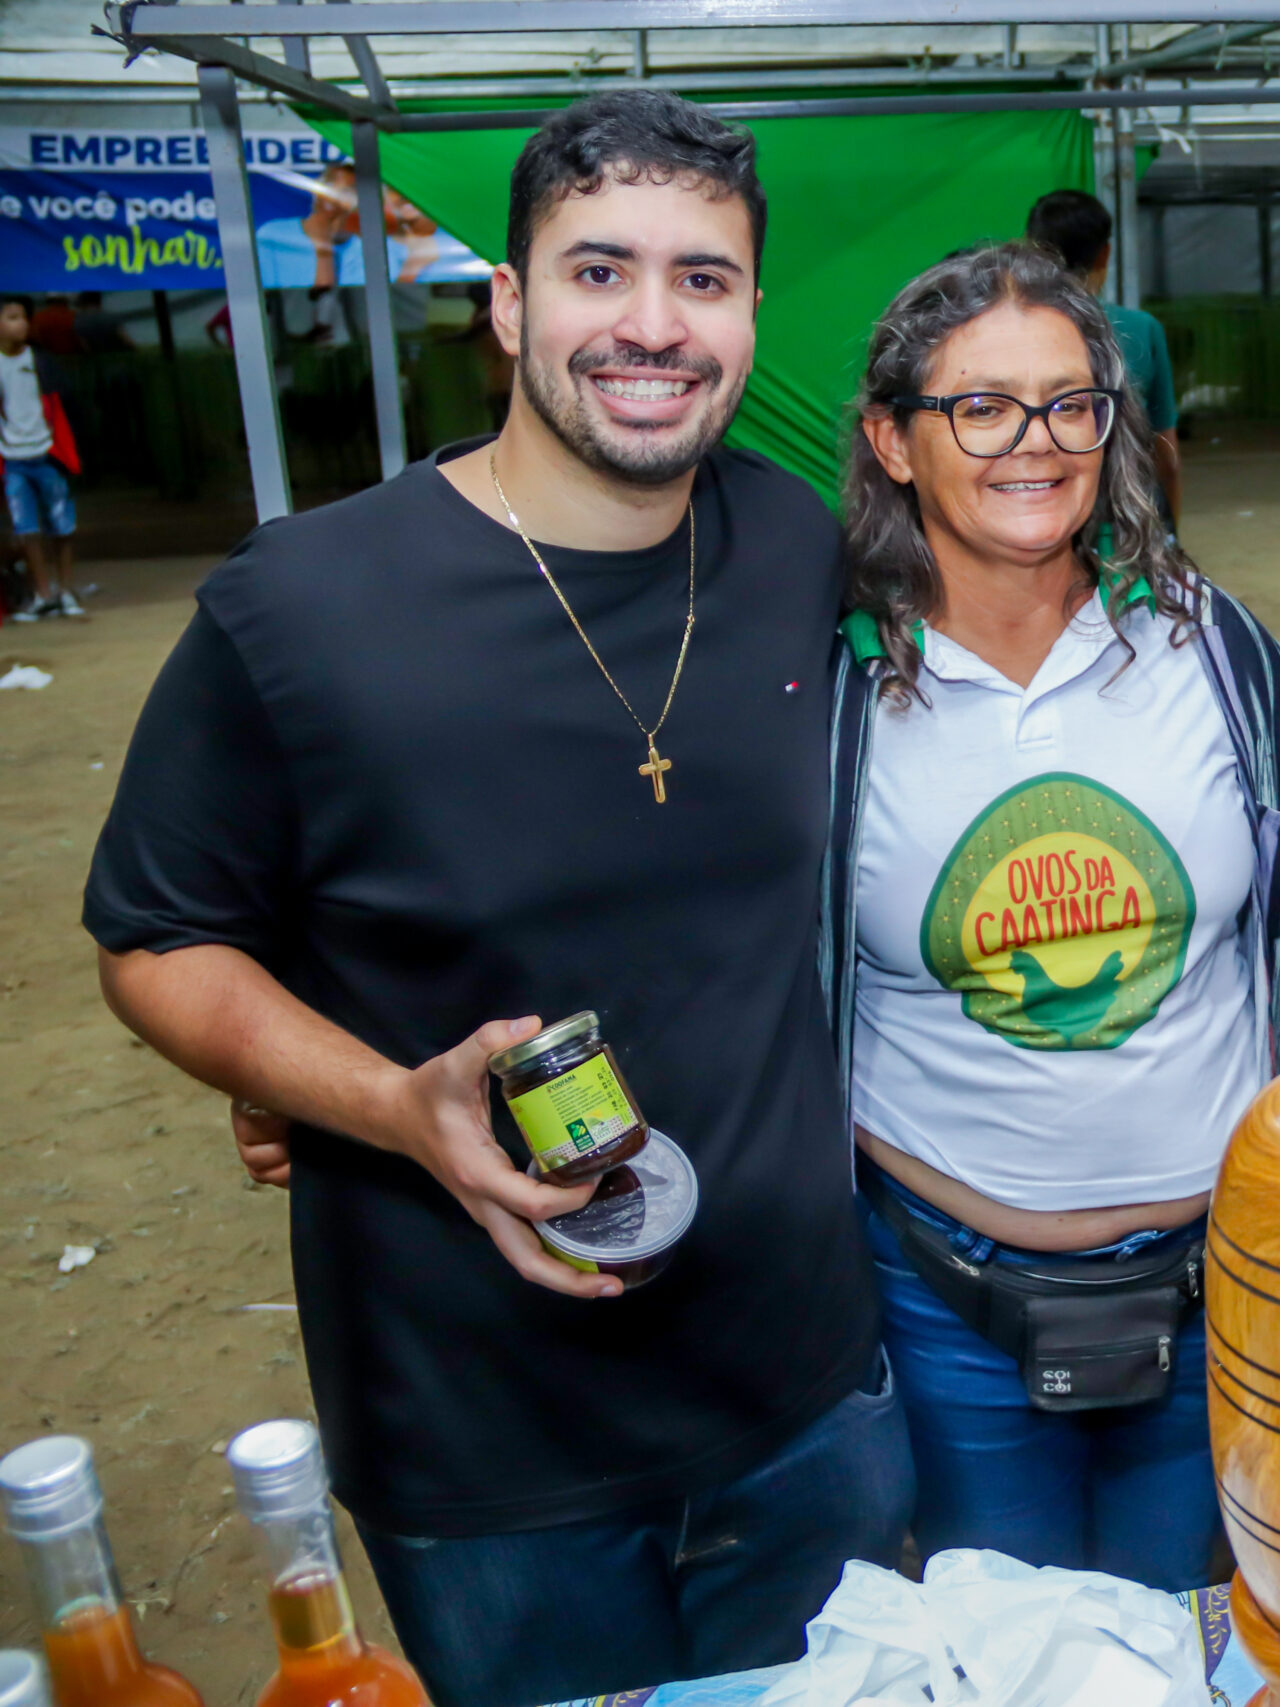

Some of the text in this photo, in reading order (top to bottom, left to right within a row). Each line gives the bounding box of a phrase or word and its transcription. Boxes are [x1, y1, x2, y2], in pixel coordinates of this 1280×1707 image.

[28, 190, 116, 219] você
[125, 191, 216, 226] pode
[62, 224, 223, 274] sonhar.
[1008, 850, 1116, 904] OVOS DA
[975, 886, 1141, 957] CAATINGA
